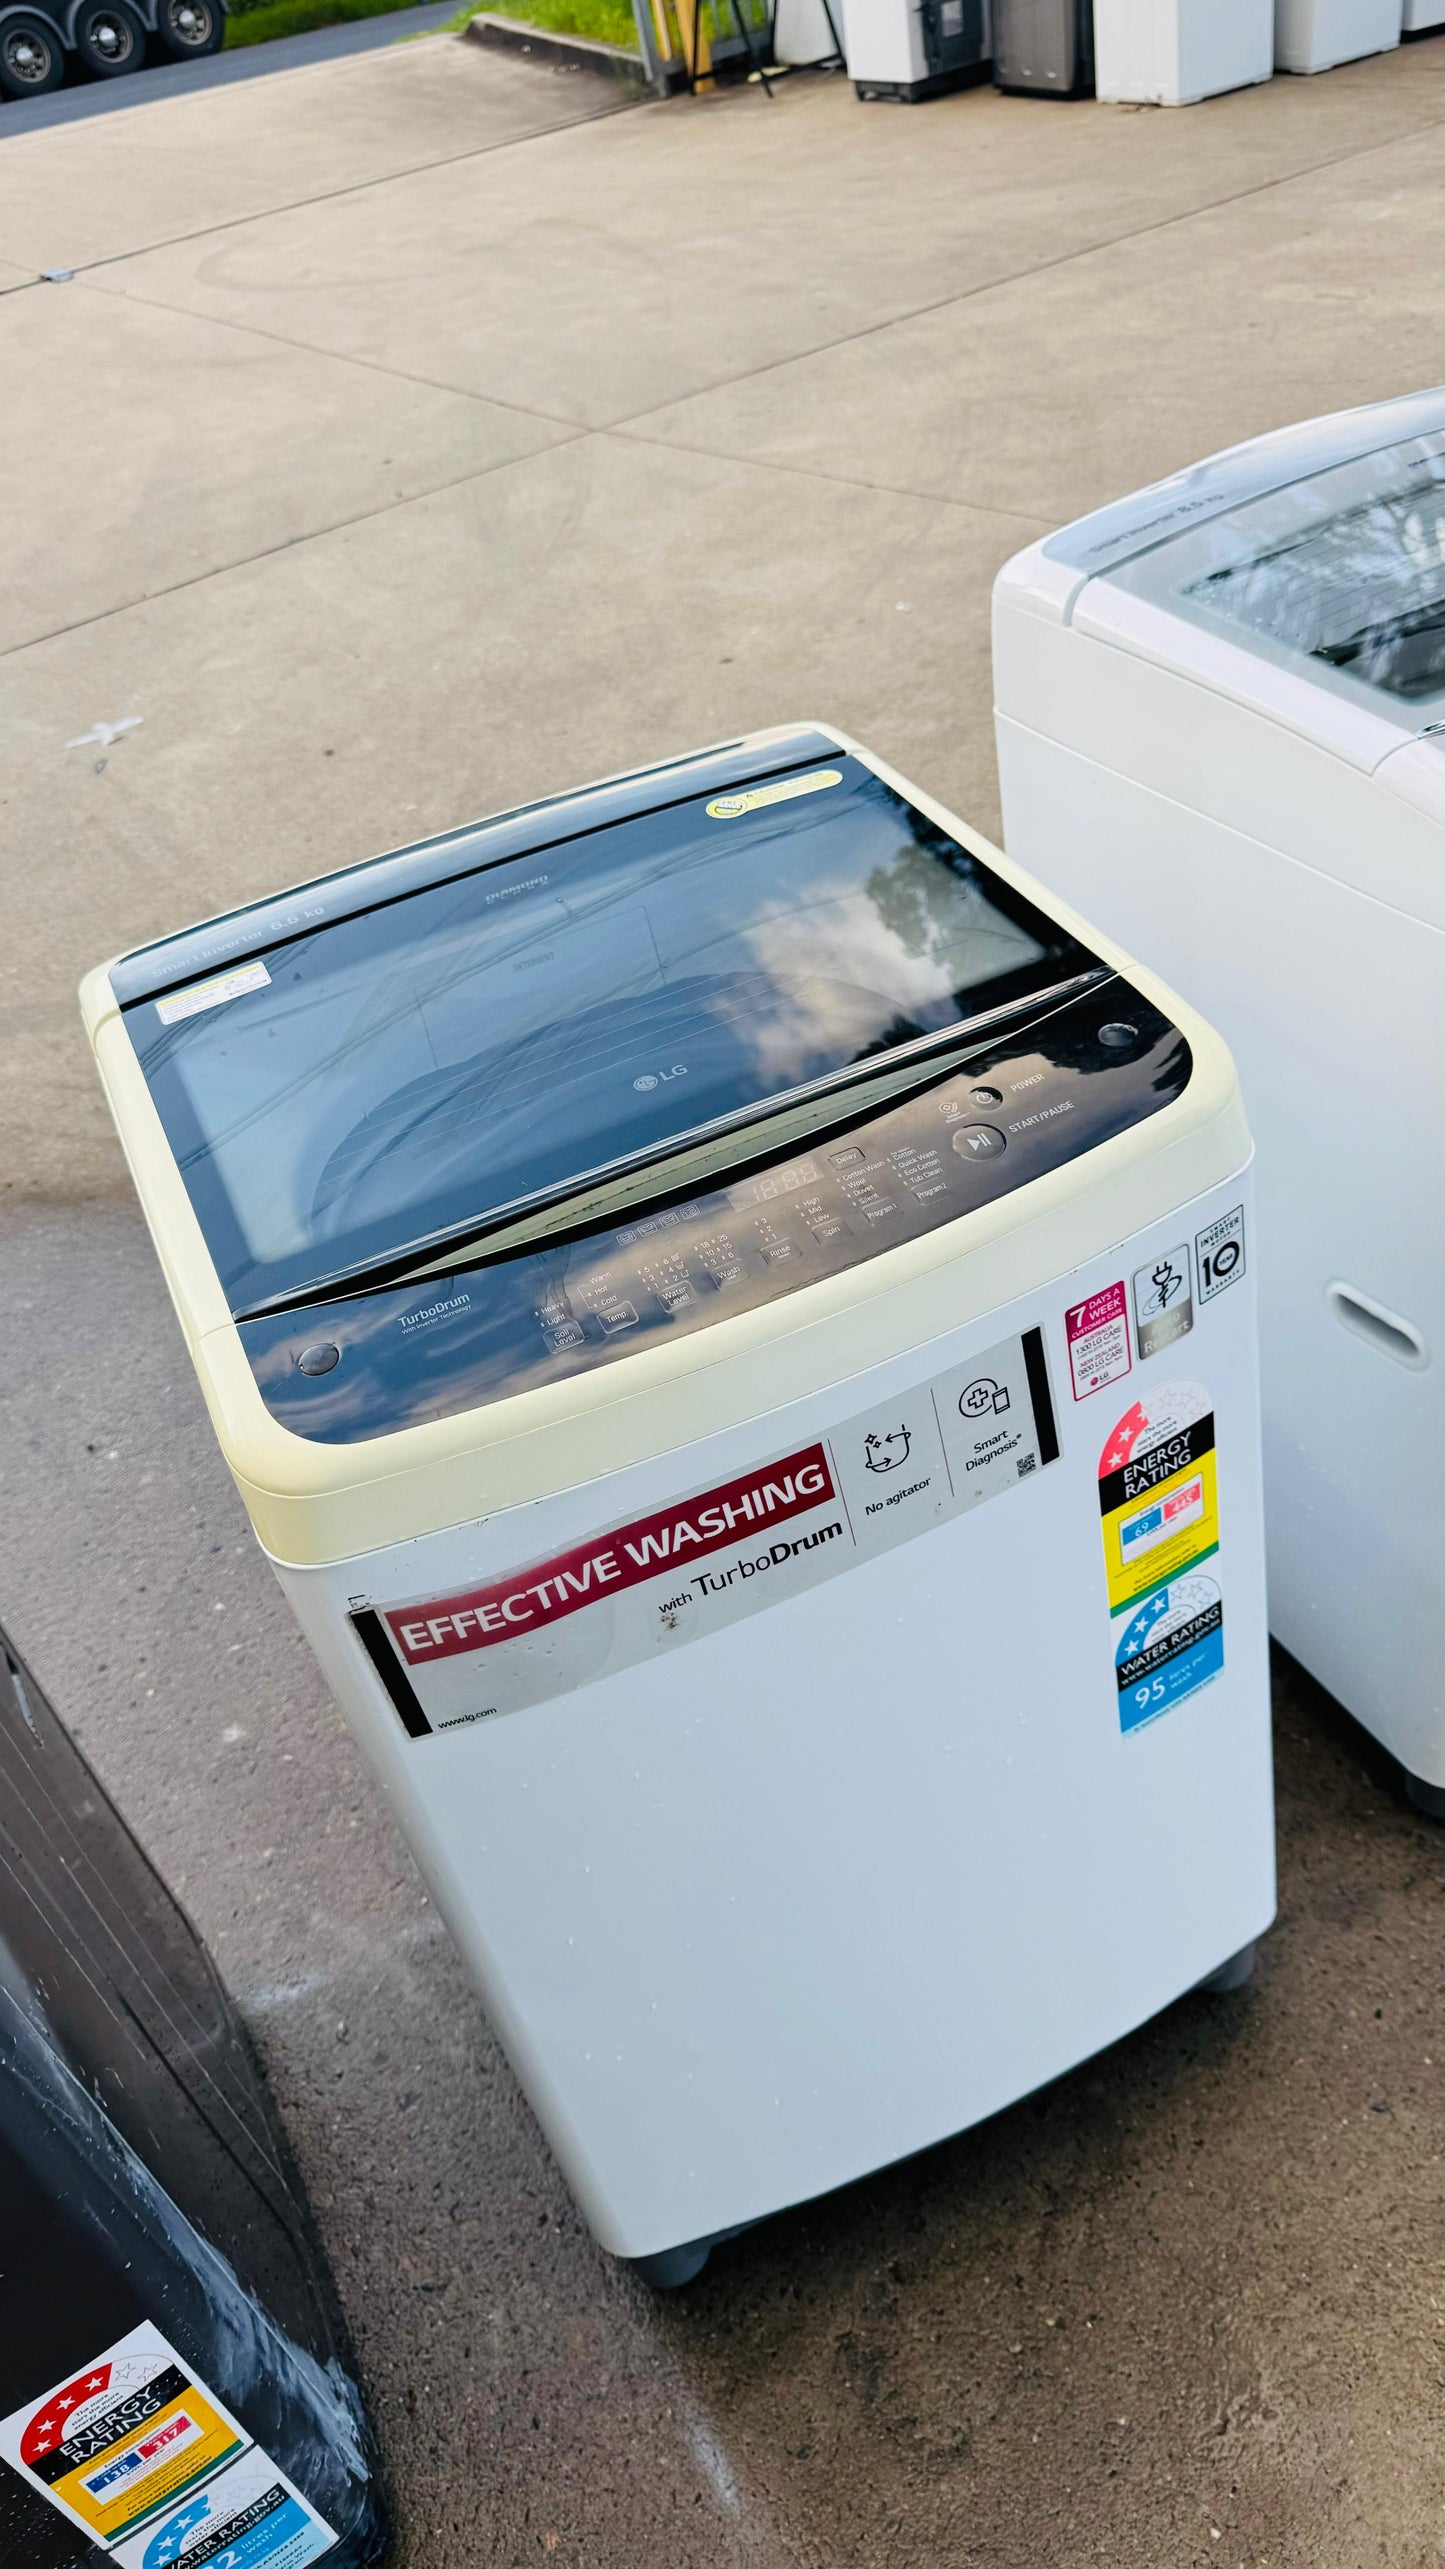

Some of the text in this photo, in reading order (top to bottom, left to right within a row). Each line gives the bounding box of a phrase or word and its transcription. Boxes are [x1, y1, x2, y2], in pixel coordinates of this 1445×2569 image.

[152, 906, 325, 978] Smart Inverter 6.5 kg
[659, 1064, 688, 1081] LG
[1010, 1073, 1045, 1092] POWER
[1008, 1100, 1075, 1133] START/PAUSE
[835, 1152, 857, 1165] Delay
[892, 1148, 916, 1160] Cotton
[898, 1157, 918, 1169] Quick
[917, 1149, 938, 1160] Wash
[842, 1160, 886, 1181] Cotton Wash
[903, 1158, 941, 1177] Eco Cotton
[911, 1167, 944, 1184] Tub Clean
[847, 1178, 867, 1189] Wool
[852, 1184, 875, 1197] Duvet
[917, 1184, 942, 1199] Program
[803, 1196, 821, 1207] High
[859, 1193, 879, 1205] Silent
[808, 1205, 823, 1215] Mid
[813, 1213, 830, 1223] Low
[867, 1205, 892, 1219] Program
[822, 1226, 840, 1237] Spin
[1200, 1216, 1240, 1248] INVERTER
[1210, 1216, 1231, 1233] SMART
[700, 1234, 728, 1249] 18 25
[1210, 1230, 1231, 1247] MOTOR
[705, 1242, 732, 1257] 10 15
[728, 1251, 734, 1259] 6
[769, 1245, 791, 1258] Rinse
[1202, 1241, 1240, 1288] 10
[1219, 1253, 1234, 1265] YEAR
[588, 1271, 612, 1285] Warm
[668, 1266, 675, 1274] 4
[673, 1274, 679, 1282] 2
[717, 1265, 740, 1279] Wash
[594, 1285, 608, 1295] Hot
[1206, 1269, 1240, 1295] WARRANTY
[601, 1294, 618, 1306] Cold
[662, 1285, 687, 1301] Water
[667, 1293, 690, 1307] Level
[1088, 1288, 1120, 1310] DAYS A
[397, 1293, 470, 1327] TurboDrum
[540, 1301, 565, 1315] Heavy
[606, 1310, 628, 1324] Temp.
[1070, 1306, 1086, 1328] 7
[1088, 1297, 1121, 1321] WEEK
[401, 1324, 417, 1335] With
[439, 1304, 472, 1321] Technology
[546, 1313, 566, 1326] Light
[1071, 1307, 1123, 1339] CUSTOMER CARE
[554, 1328, 570, 1340] Soil
[554, 1334, 576, 1347] Level
[1076, 1342, 1092, 1355] 1300
[1092, 1336, 1103, 1347] LG
[1103, 1325, 1122, 1340] CARE
[1083, 1324, 1114, 1343] AUSTRALIA
[1078, 1363, 1095, 1376] 0800
[1095, 1357, 1105, 1368] LG
[1105, 1347, 1123, 1361] CARE
[1080, 1357, 1094, 1368] NEW
[1094, 1342, 1121, 1360] ZEALAND
[1099, 1371, 1109, 1380] LG
[974, 1430, 1009, 1454] Smart
[1123, 1431, 1192, 1484] ENERGY
[1125, 1449, 1192, 1499] RATING
[865, 1477, 931, 1516] No agitator
[1135, 1522, 1149, 1537] 69
[399, 1463, 826, 1653] EFFECTIVE WASHING
[658, 1522, 844, 1615] with TurboDrum
[1121, 1643, 1169, 1676] WATER
[1170, 1606, 1220, 1650] RATING
[1135, 1676, 1166, 1709] 95
[437, 1706, 498, 1730] www.lg.com
[59, 2386, 151, 2457] ENERGY
[71, 2398, 161, 2465] RATING
[153, 2427, 179, 2451] 317
[103, 2463, 130, 2484] 138
[218, 2489, 280, 2540] RATING
[241, 2528, 268, 2550] litres
[271, 2512, 287, 2530] per
[247, 2533, 273, 2553] wash
